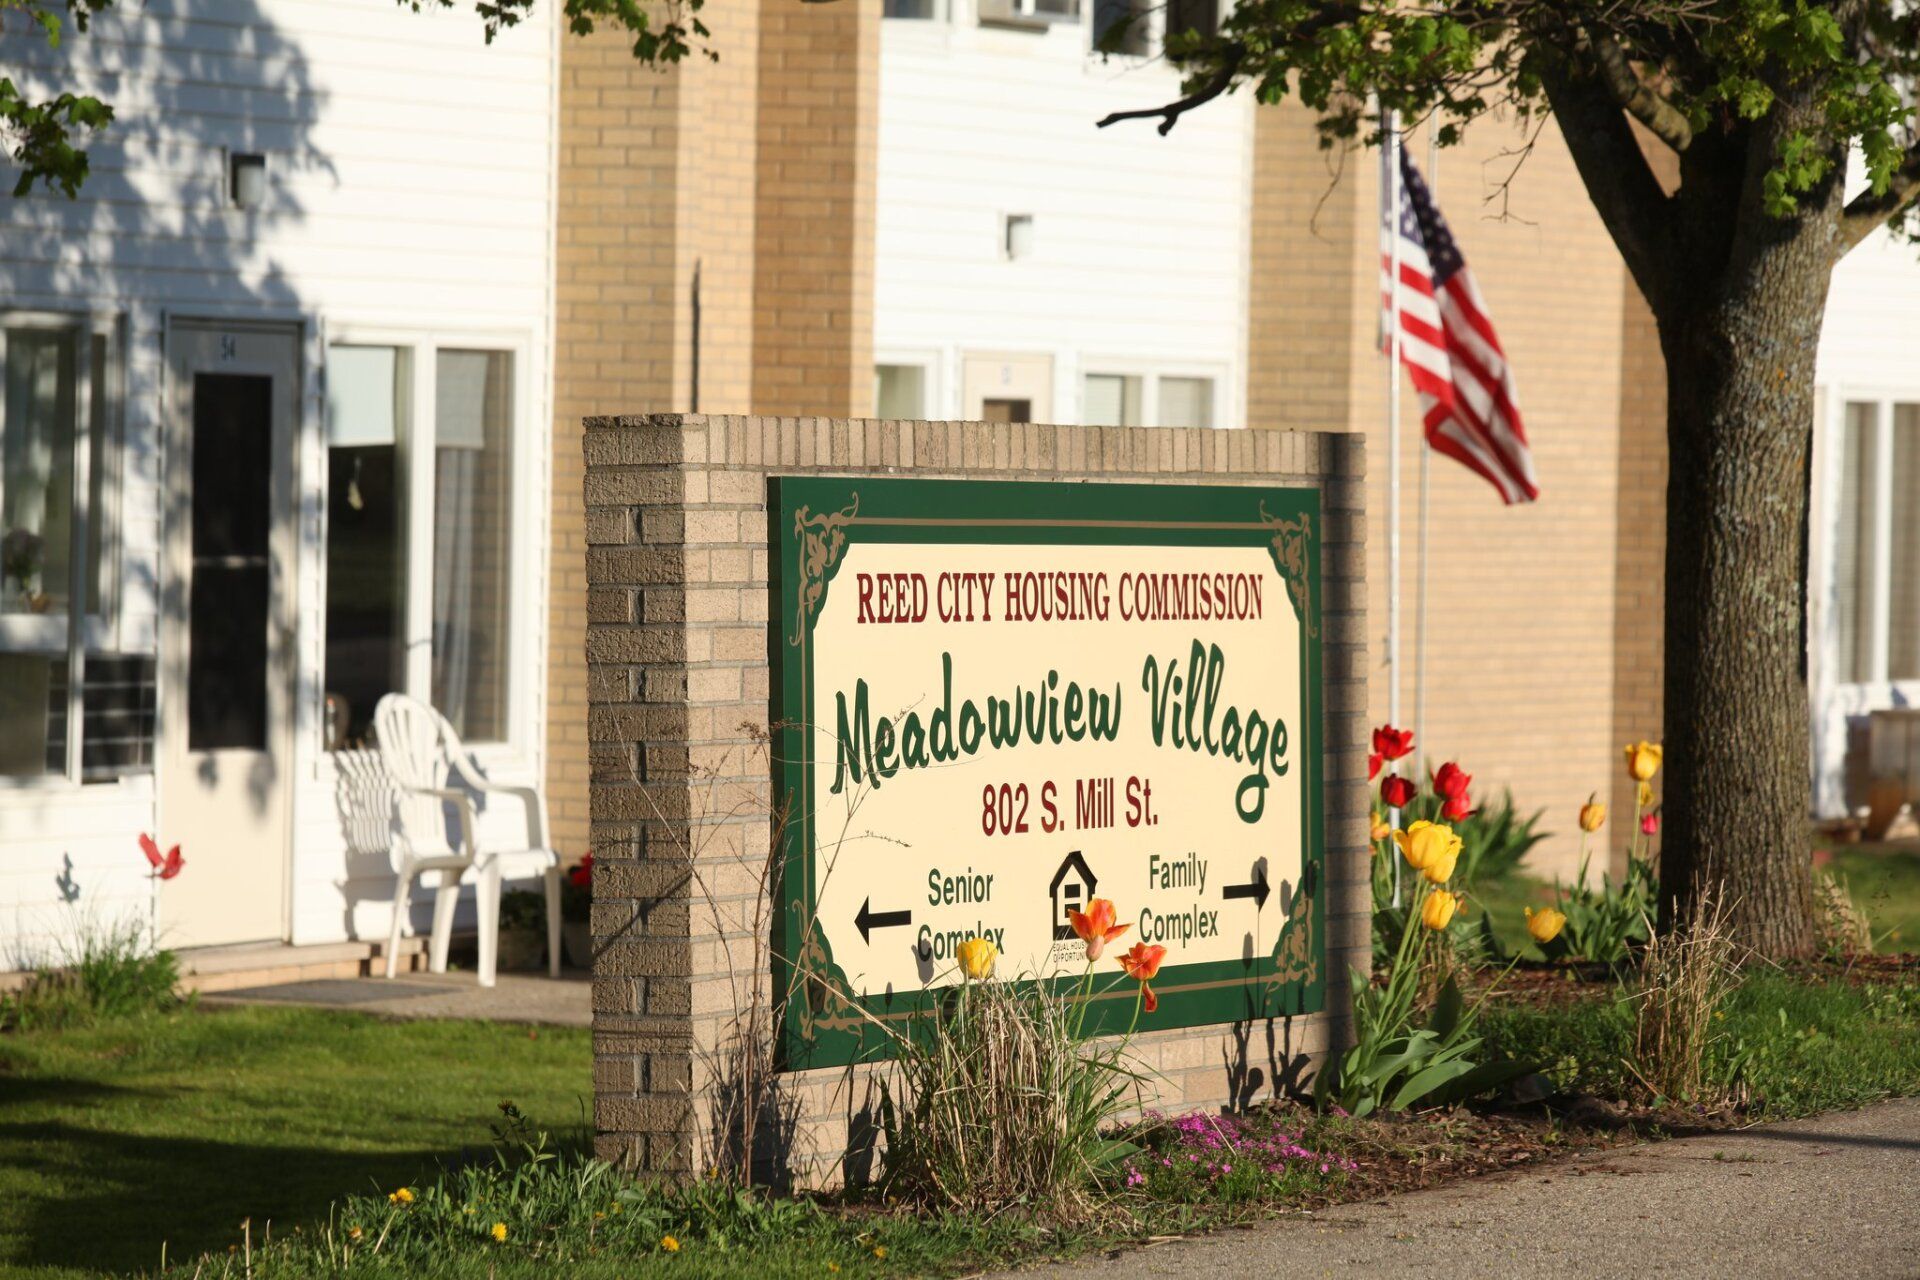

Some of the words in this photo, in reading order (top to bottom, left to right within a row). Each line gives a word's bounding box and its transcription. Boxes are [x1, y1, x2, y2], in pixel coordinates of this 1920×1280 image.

[857, 573, 927, 624] REED
[936, 573, 995, 623] CITY
[1004, 571, 1109, 621] HOUSING
[1118, 573, 1263, 621] COMMISSION
[830, 651, 1121, 794] Meadowview
[1142, 638, 1289, 823] Village
[981, 782, 1029, 836] 802
[1040, 781, 1065, 833] S.
[1075, 777, 1114, 829] Mill
[1125, 776, 1158, 827] St.
[928, 867, 994, 906] Senior
[1149, 853, 1207, 895] Family
[1139, 904, 1218, 948] Complex
[1053, 951, 1087, 963] OPPORTUN
